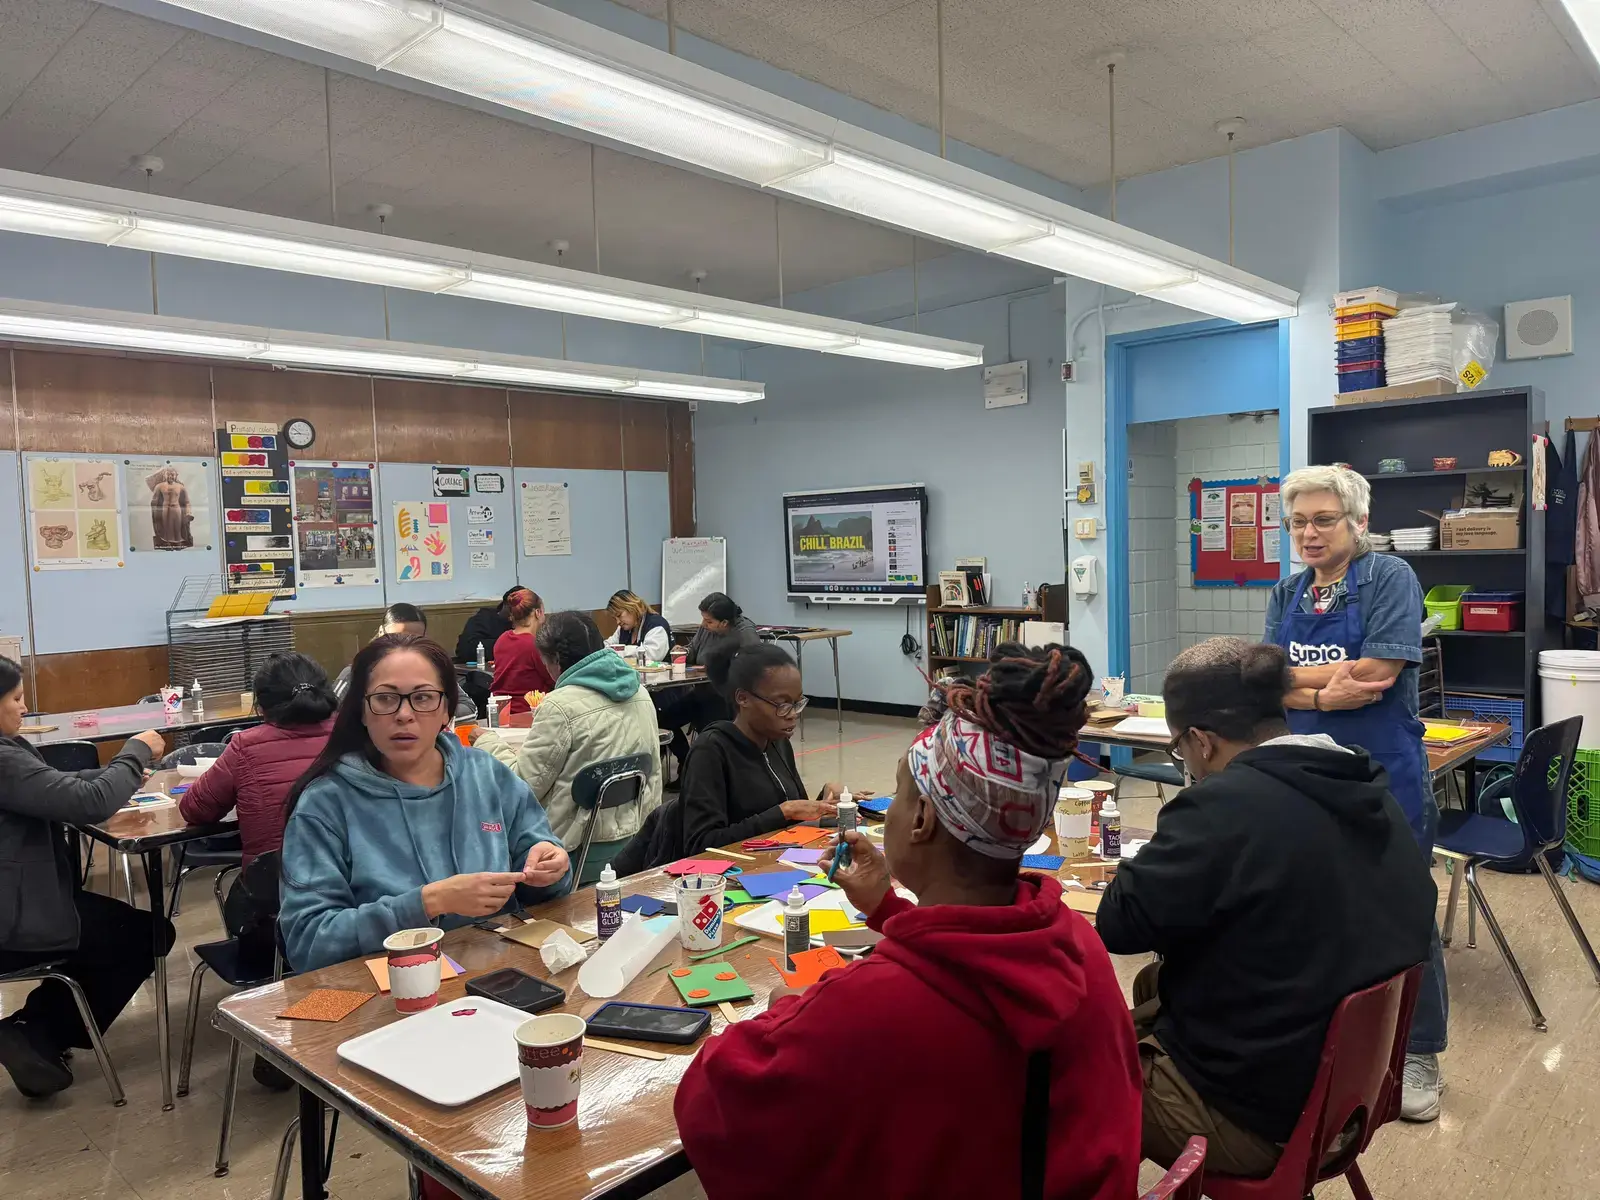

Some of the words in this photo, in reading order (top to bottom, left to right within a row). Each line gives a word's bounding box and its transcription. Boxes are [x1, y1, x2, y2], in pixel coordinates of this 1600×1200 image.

[800, 537, 827, 551] CHILL
[830, 535, 865, 550] BRAZIL
[602, 917, 620, 925] GLUE
